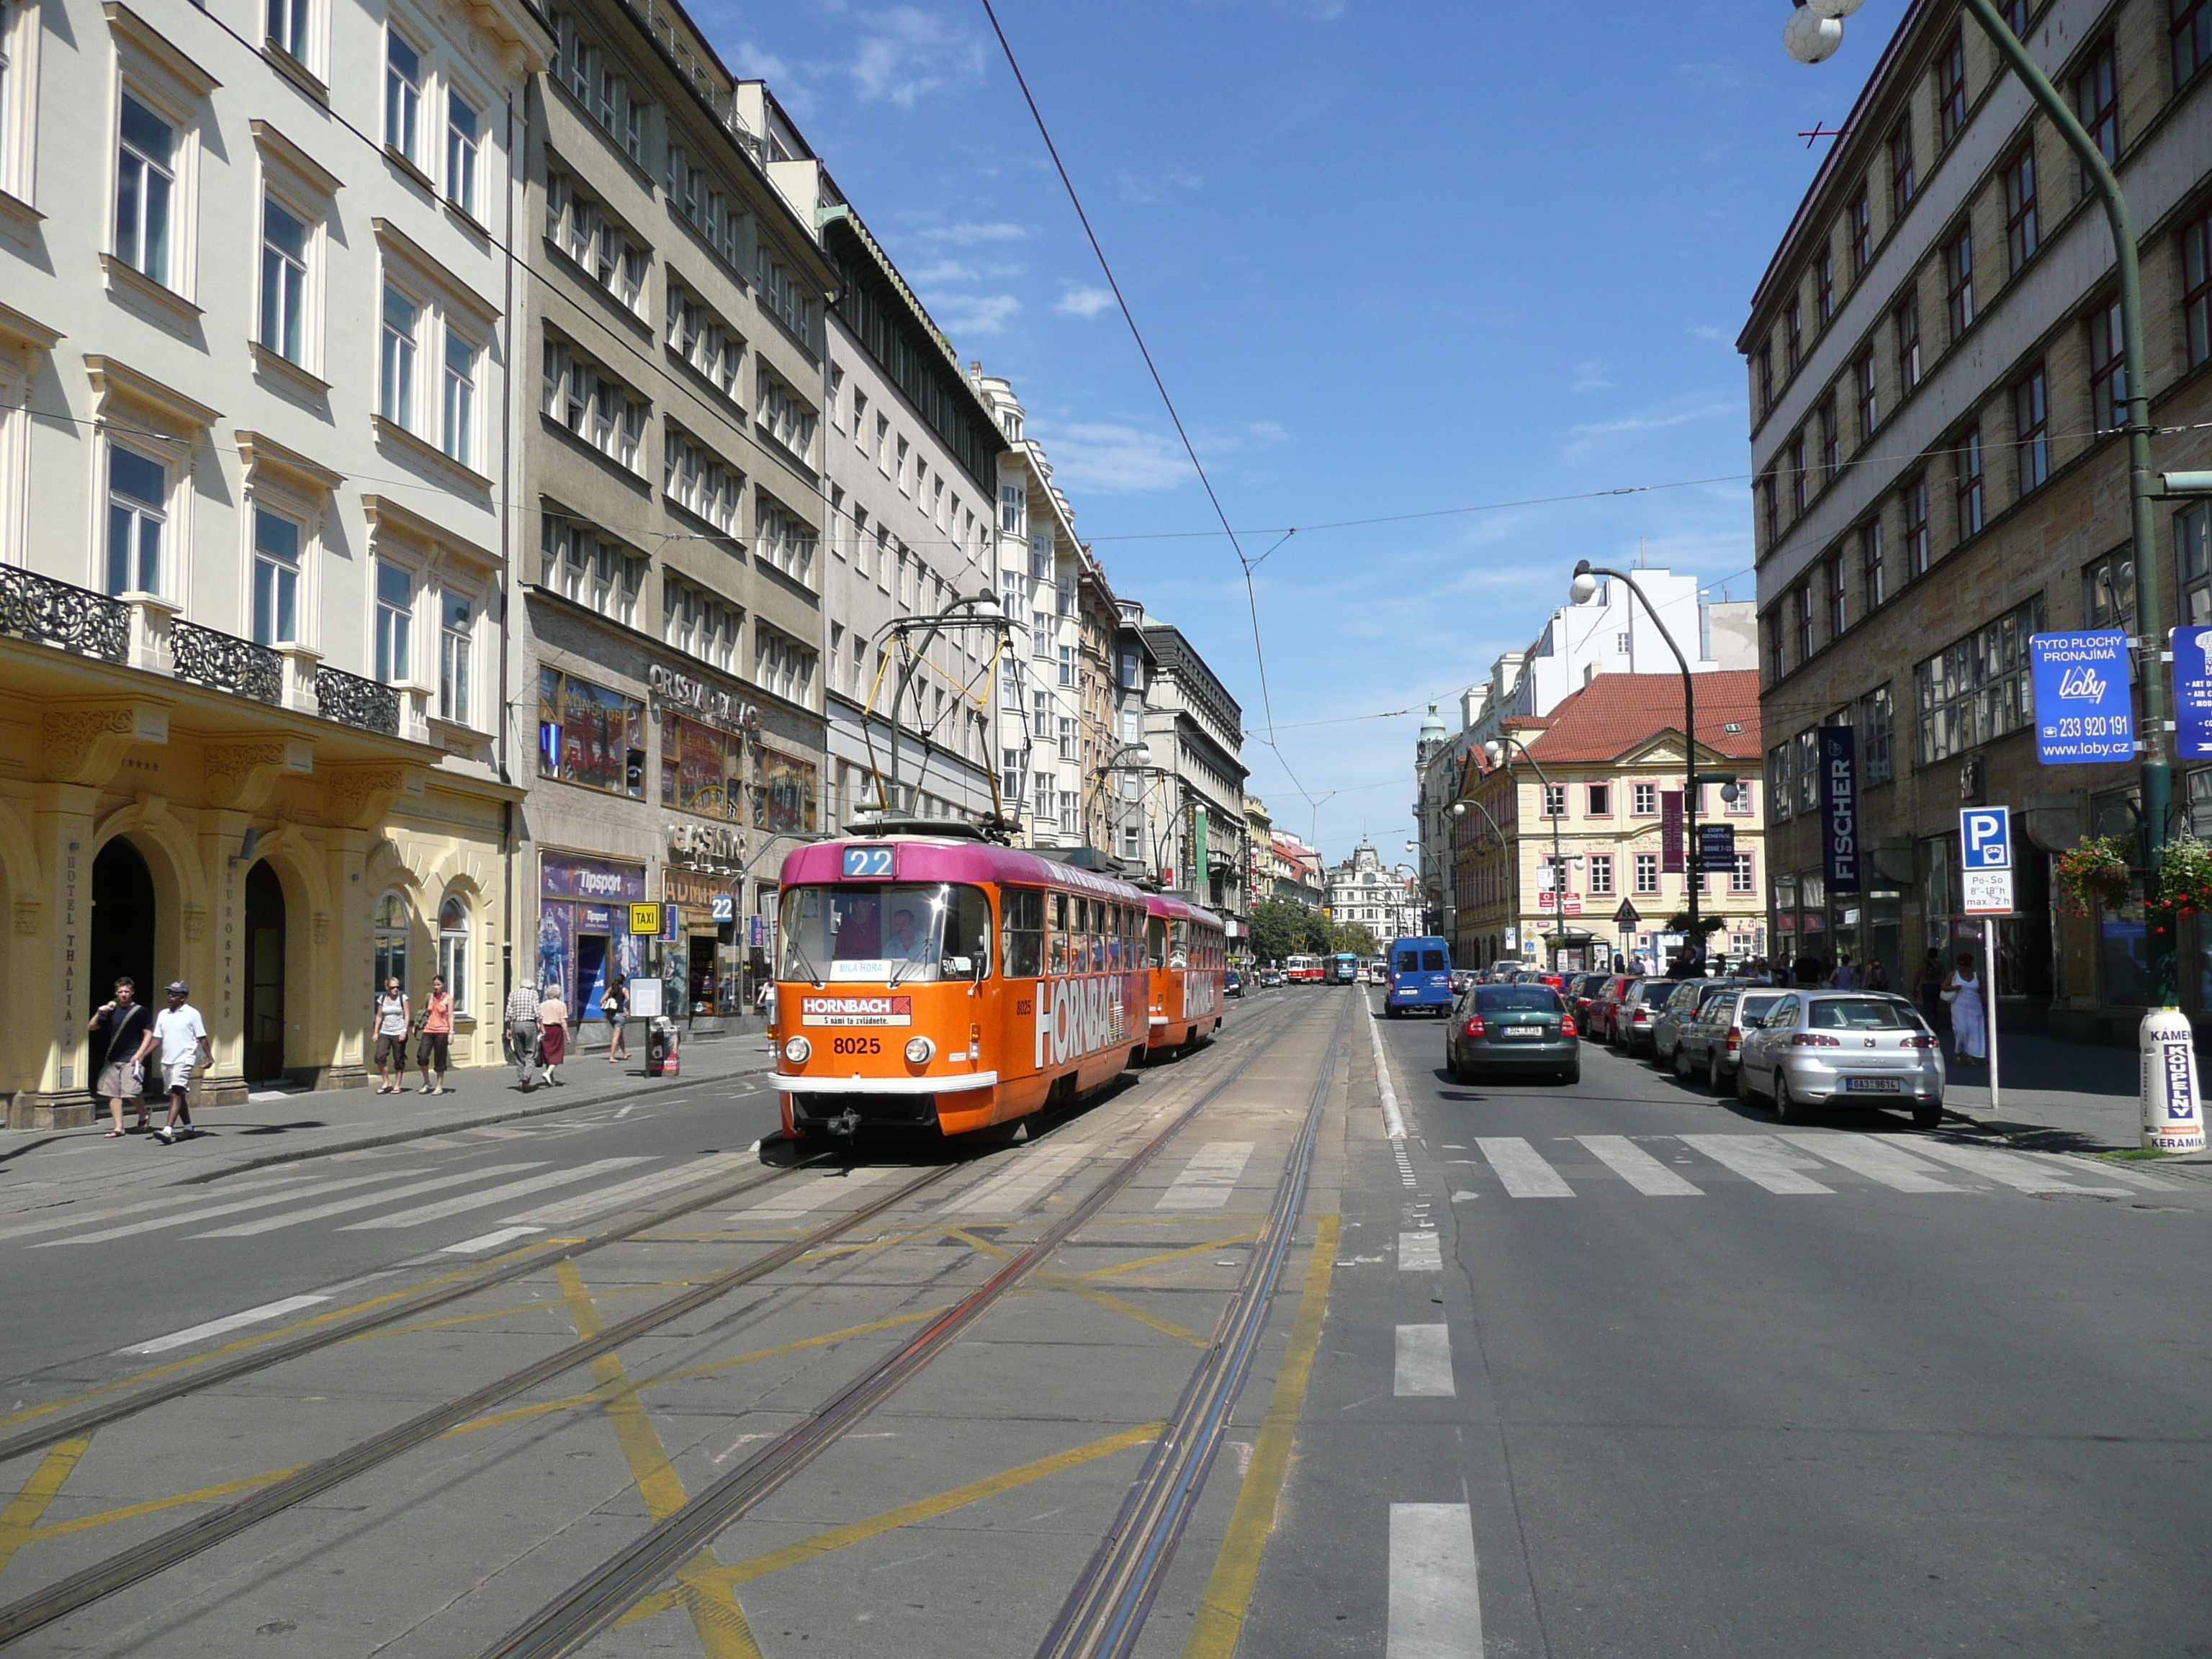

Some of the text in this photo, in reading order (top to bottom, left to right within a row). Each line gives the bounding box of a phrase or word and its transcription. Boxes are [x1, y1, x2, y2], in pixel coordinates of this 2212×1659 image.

[2036, 637, 2122, 649] TYTO PLOCHY
[2044, 648, 2116, 662] PRONAJÍMÁ
[2059, 716, 2128, 737] 233 920 191
[2043, 742, 2129, 756] www.loby.cz
[1832, 759, 1854, 879] FISCHER
[1663, 809, 1672, 851] ENGLISH
[1970, 816, 1998, 850] P
[850, 850, 891, 876] 22
[580, 869, 621, 894] Tipsport
[1972, 876, 2003, 884] Po-So
[587, 910, 608, 922] Tipsport
[712, 899, 732, 918] 22
[636, 912, 655, 925] TAXI
[65, 857, 76, 1020] HOTEL THALIA
[224, 873, 233, 1017] EUROSTARS
[840, 962, 883, 973] BÍLÁ HORA
[804, 999, 891, 1013] HORNBACH
[1017, 1000, 1032, 1015] 8025
[1035, 974, 1125, 1069] HORNBACH
[834, 1038, 881, 1054] 8025
[1853, 1079, 1895, 1089] 6A3 9614
[2168, 1046, 2188, 1117] KOUPELNY
